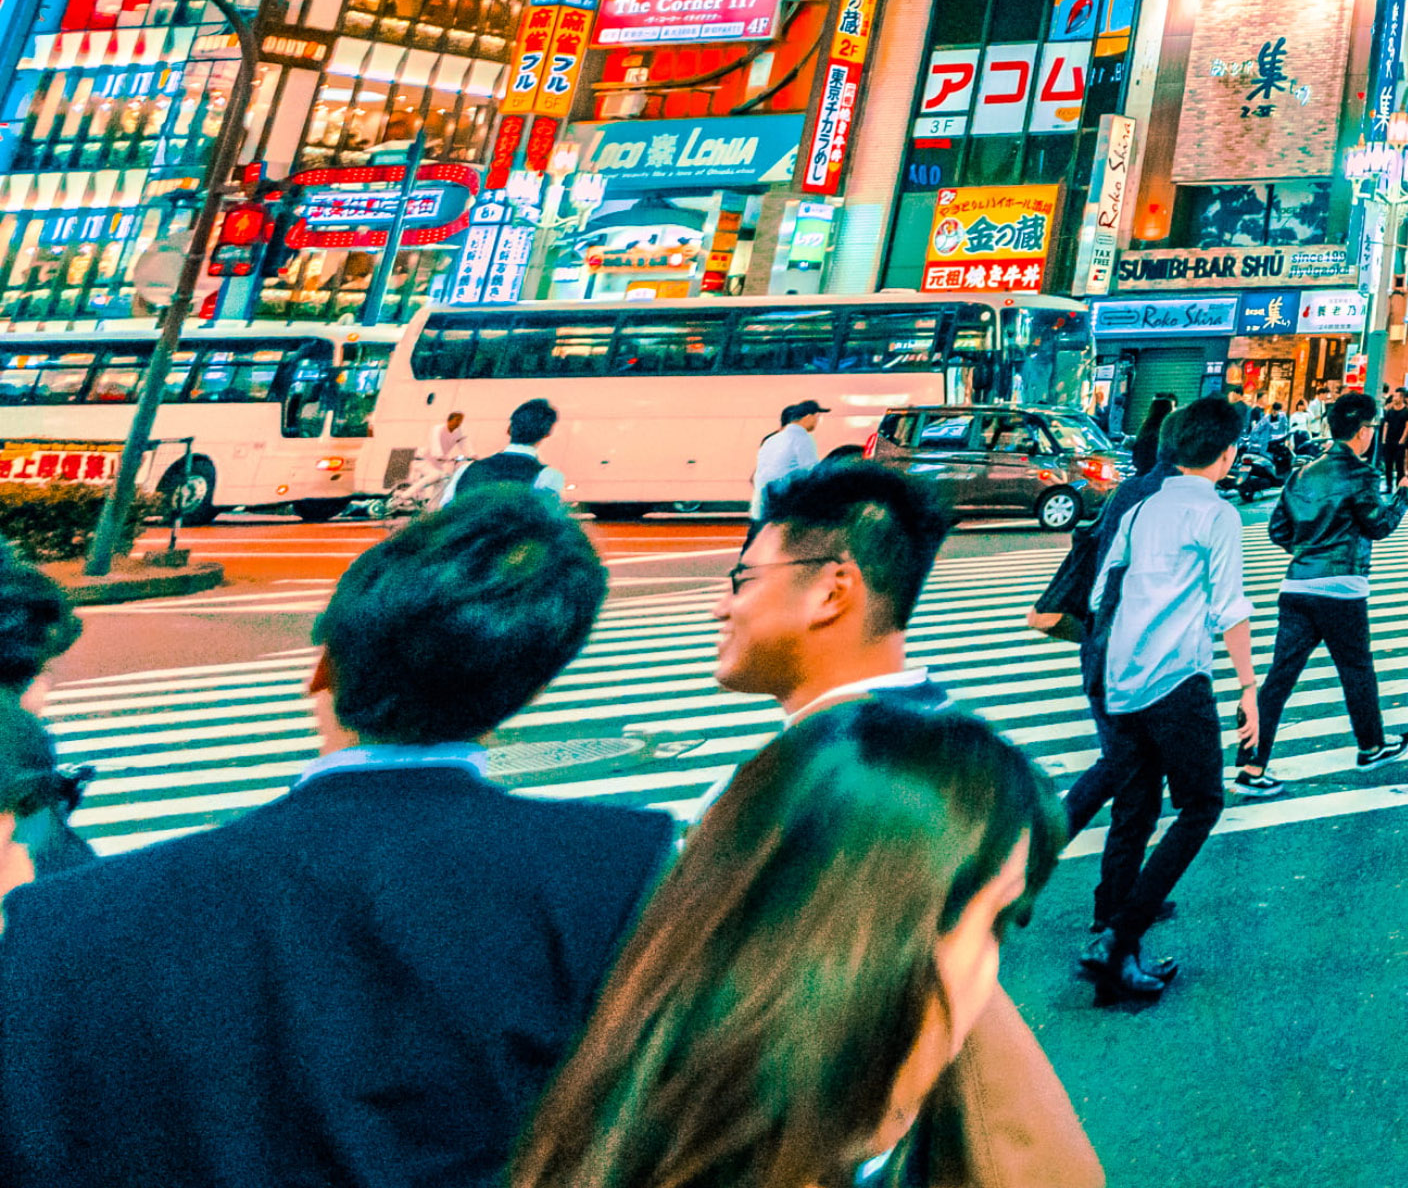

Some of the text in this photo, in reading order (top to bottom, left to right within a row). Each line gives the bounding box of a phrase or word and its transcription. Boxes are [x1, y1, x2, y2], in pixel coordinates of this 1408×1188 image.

[747, 17, 769, 34] 4F
[839, 39, 860, 59] 2F
[925, 57, 1085, 109] アコム
[811, 69, 847, 181] 東京チカラめし
[930, 118, 954, 134] 3F
[964, 215, 1045, 253] 金の蔵
[1094, 250, 1111, 259] TAX
[1142, 308, 1178, 329] Roko
